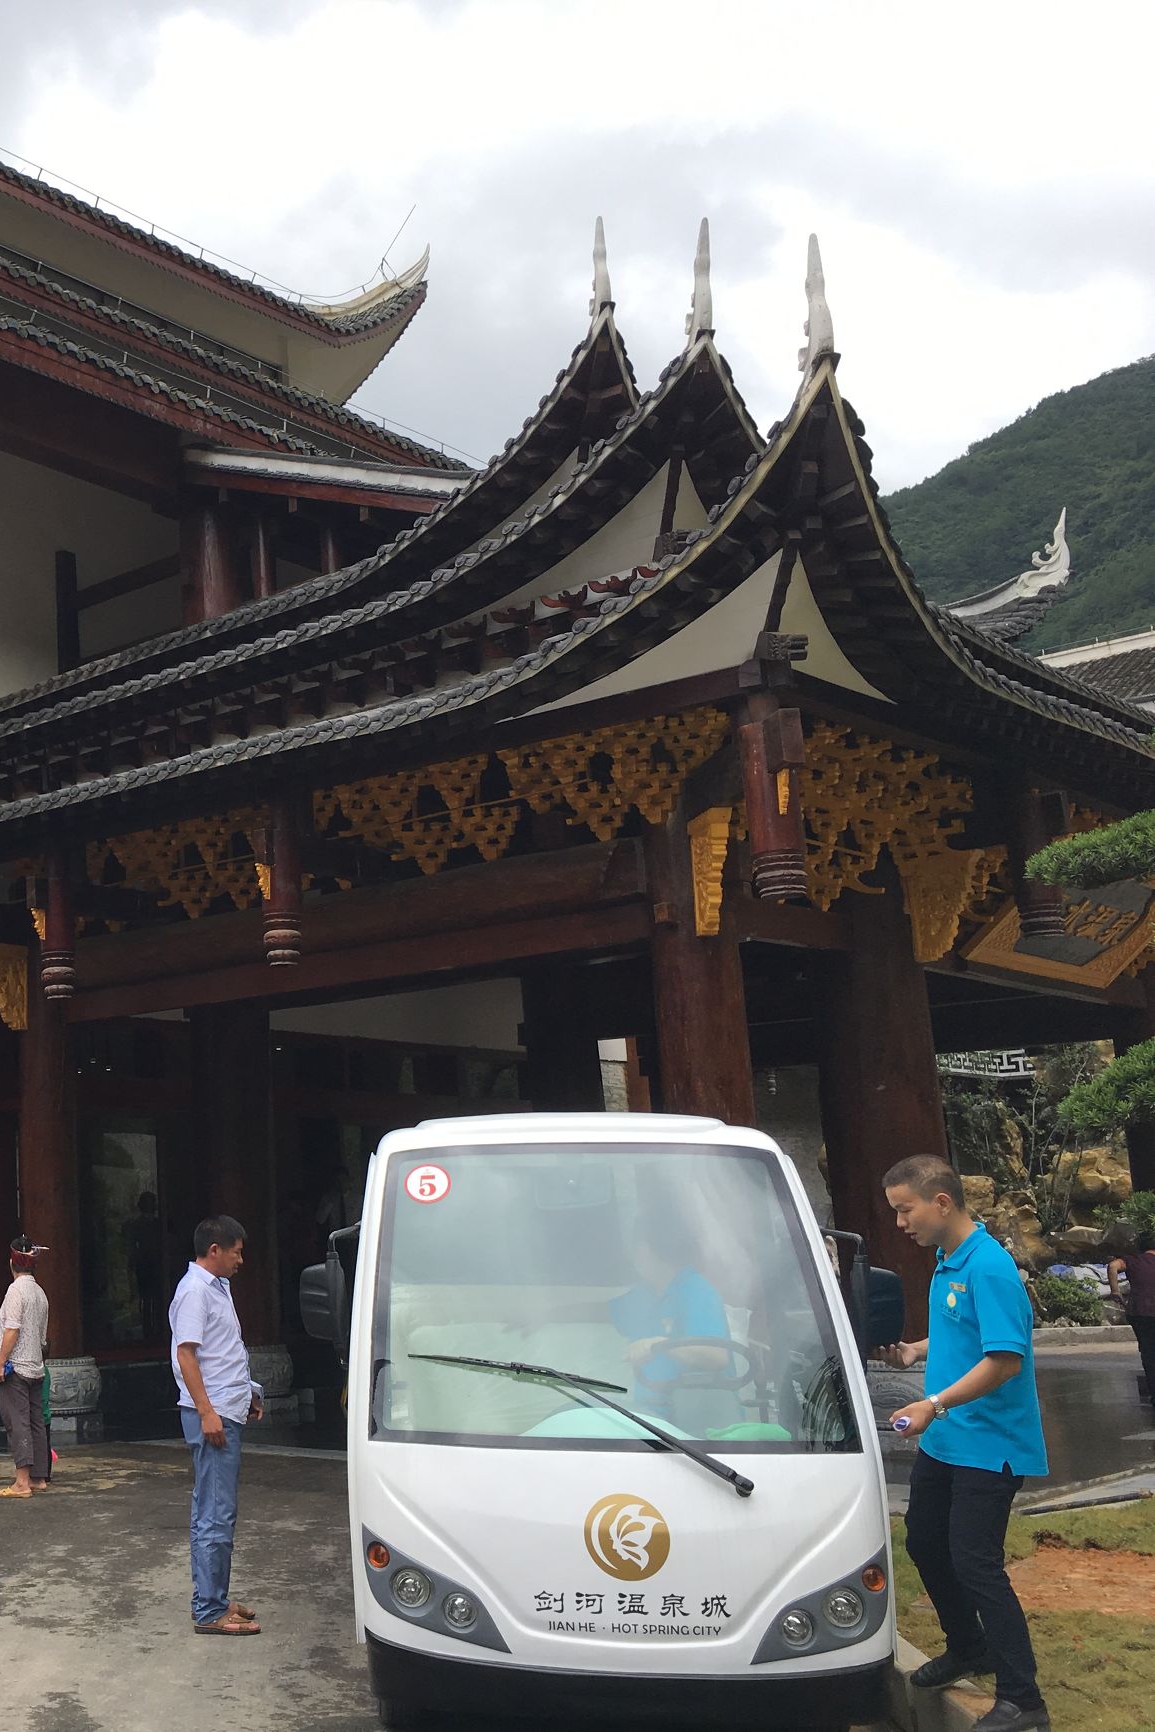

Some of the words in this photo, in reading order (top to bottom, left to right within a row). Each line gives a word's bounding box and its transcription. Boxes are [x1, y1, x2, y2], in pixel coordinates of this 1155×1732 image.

[419, 1174, 436, 1196] 5
[533, 1590, 732, 1618] 剑河温泉城
[548, 1620, 575, 1632] JIAN
[578, 1622, 596, 1633] HE
[611, 1623, 639, 1634] HOT
[642, 1624, 690, 1636] SPRING
[692, 1625, 721, 1636] CITY
